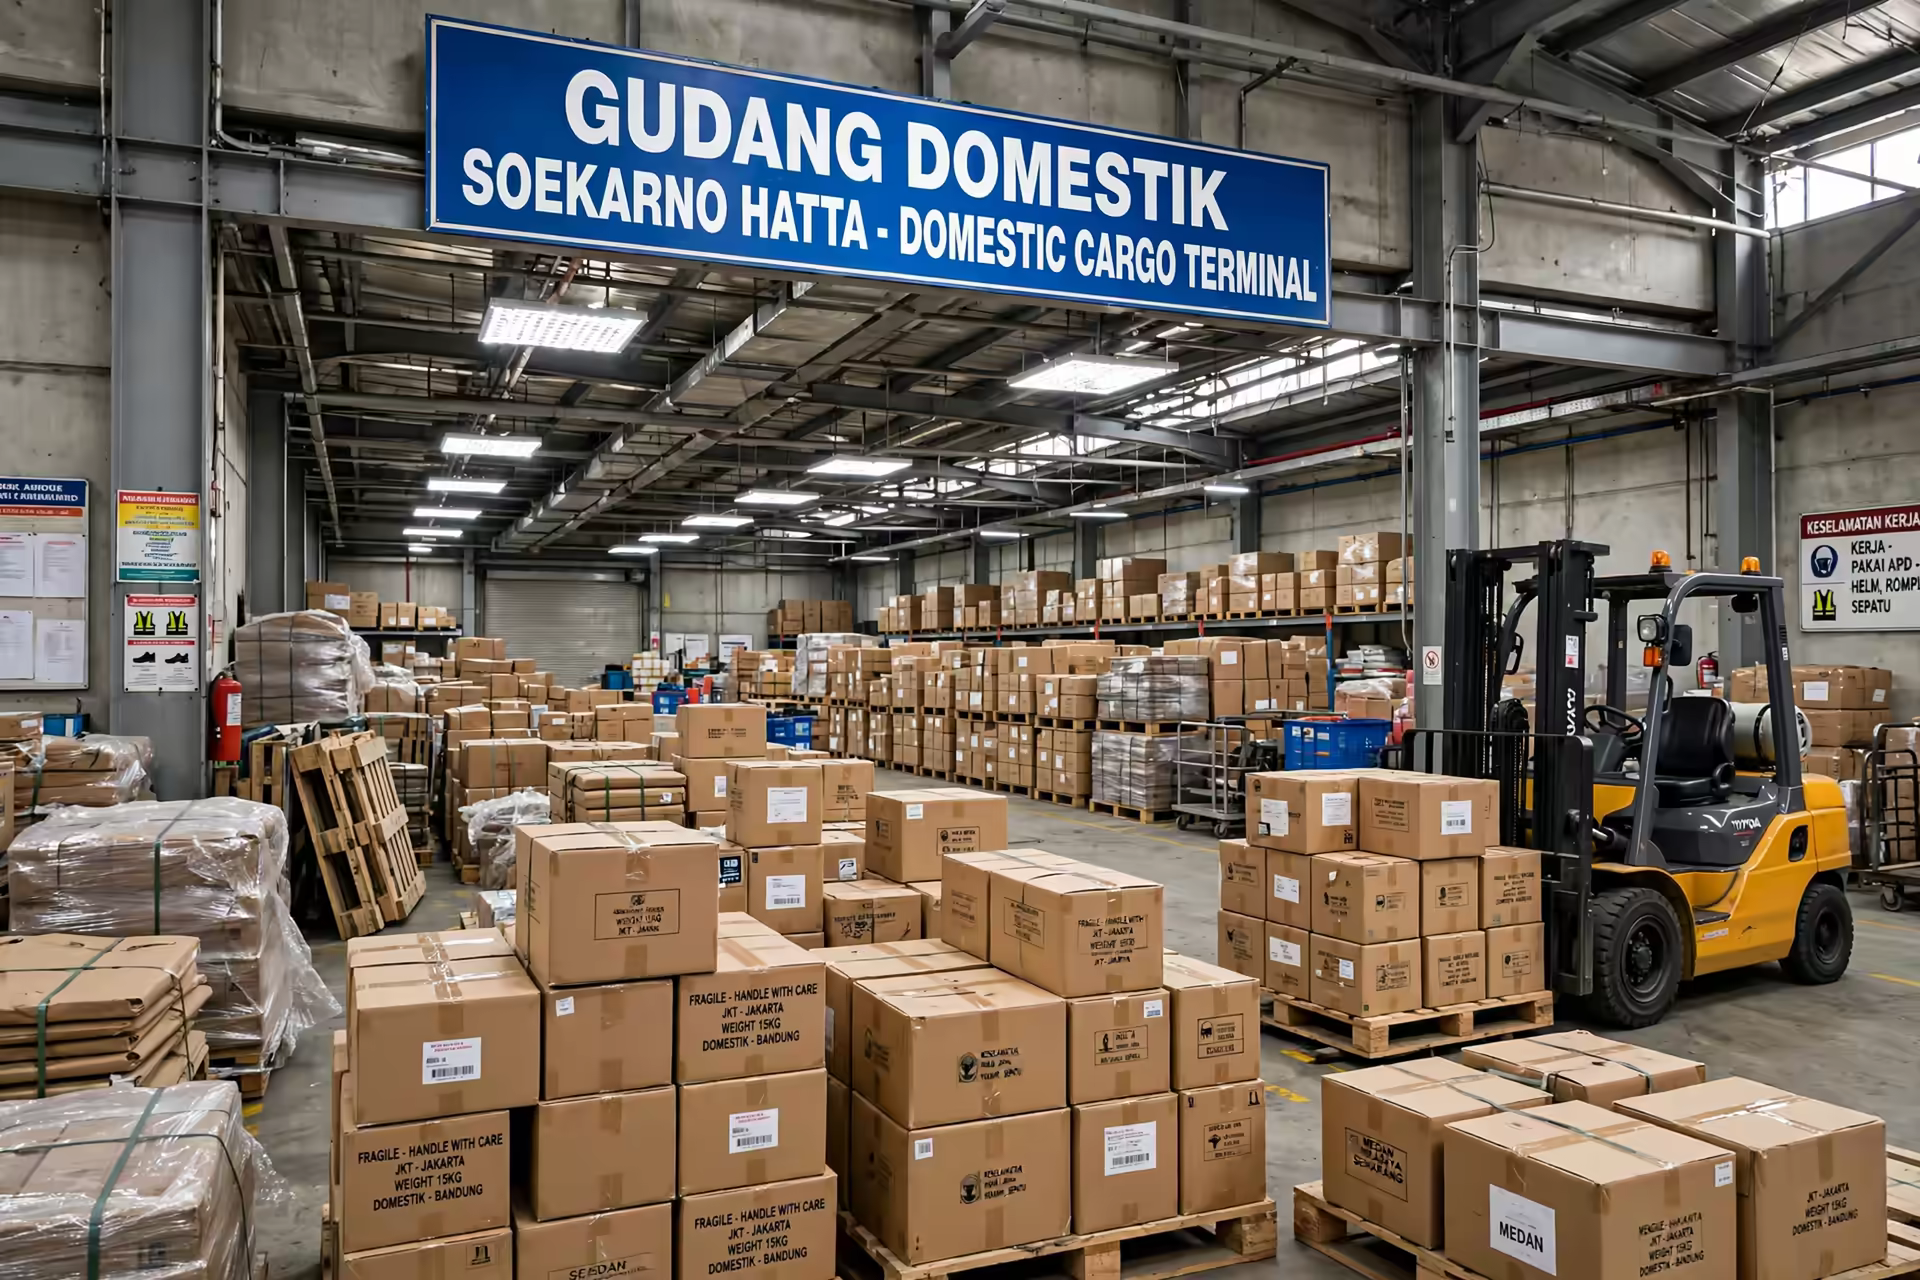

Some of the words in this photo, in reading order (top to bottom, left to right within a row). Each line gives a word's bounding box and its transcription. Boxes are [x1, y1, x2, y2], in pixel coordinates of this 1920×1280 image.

[565, 69, 882, 183] GUDANG
[907, 121, 1229, 231] DOMESTIK
[462, 147, 727, 233] SOEKARNO
[742, 184, 868, 250] HATTA
[877, 227, 888, 238] -
[900, 206, 1066, 273] DOMESTIC
[1074, 228, 1176, 286] CARGO
[1184, 244, 1317, 302] TERMINAL
[1807, 515, 1881, 535] KESELAMATAN
[1884, 511, 1920, 529] KERJA
[1851, 540, 1885, 555] KERJA
[1851, 558, 1885, 574] PAKAI
[1888, 556, 1912, 572] APD
[1851, 578, 1882, 595] HELM,
[1851, 599, 1891, 613] SEPATU
[689, 991, 726, 1006] FRAGILE
[734, 987, 769, 1002] HANDLE
[771, 985, 793, 998] WITH
[795, 983, 818, 995] CARE
[721, 1006, 738, 1019] JKT
[745, 1002, 784, 1016] JAKARTA
[721, 1020, 756, 1034] WEIGHT
[758, 1017, 781, 1031] 15KG
[702, 1035, 749, 1052] DOMESTIK
[756, 1030, 800, 1046] BANDUNG
[358, 1147, 400, 1164] FRAGILE
[409, 1140, 449, 1158] HANDLE
[451, 1136, 476, 1152] WITH
[478, 1132, 503, 1148] CARE
[395, 1161, 413, 1176] JKT
[421, 1155, 465, 1172] JAKARTA
[394, 1174, 434, 1192] WEIGHT
[437, 1171, 462, 1186] 15KG
[373, 1192, 426, 1211] DOMESTIK
[434, 1183, 483, 1202] BANDUNG
[694, 1213, 733, 1230] FRAGILE
[740, 1206, 776, 1223] HANDLE
[778, 1202, 801, 1216] WITH
[802, 1198, 825, 1212] CARE
[728, 1227, 744, 1240] JKT
[751, 1219, 791, 1236] JAKARTA
[1499, 1221, 1544, 1253] MEDAN
[727, 1239, 763, 1256] WEIGHT
[766, 1235, 788, 1249] 15KG
[708, 1255, 756, 1275] DOMESTIK
[763, 1246, 808, 1264] BANDUNG
